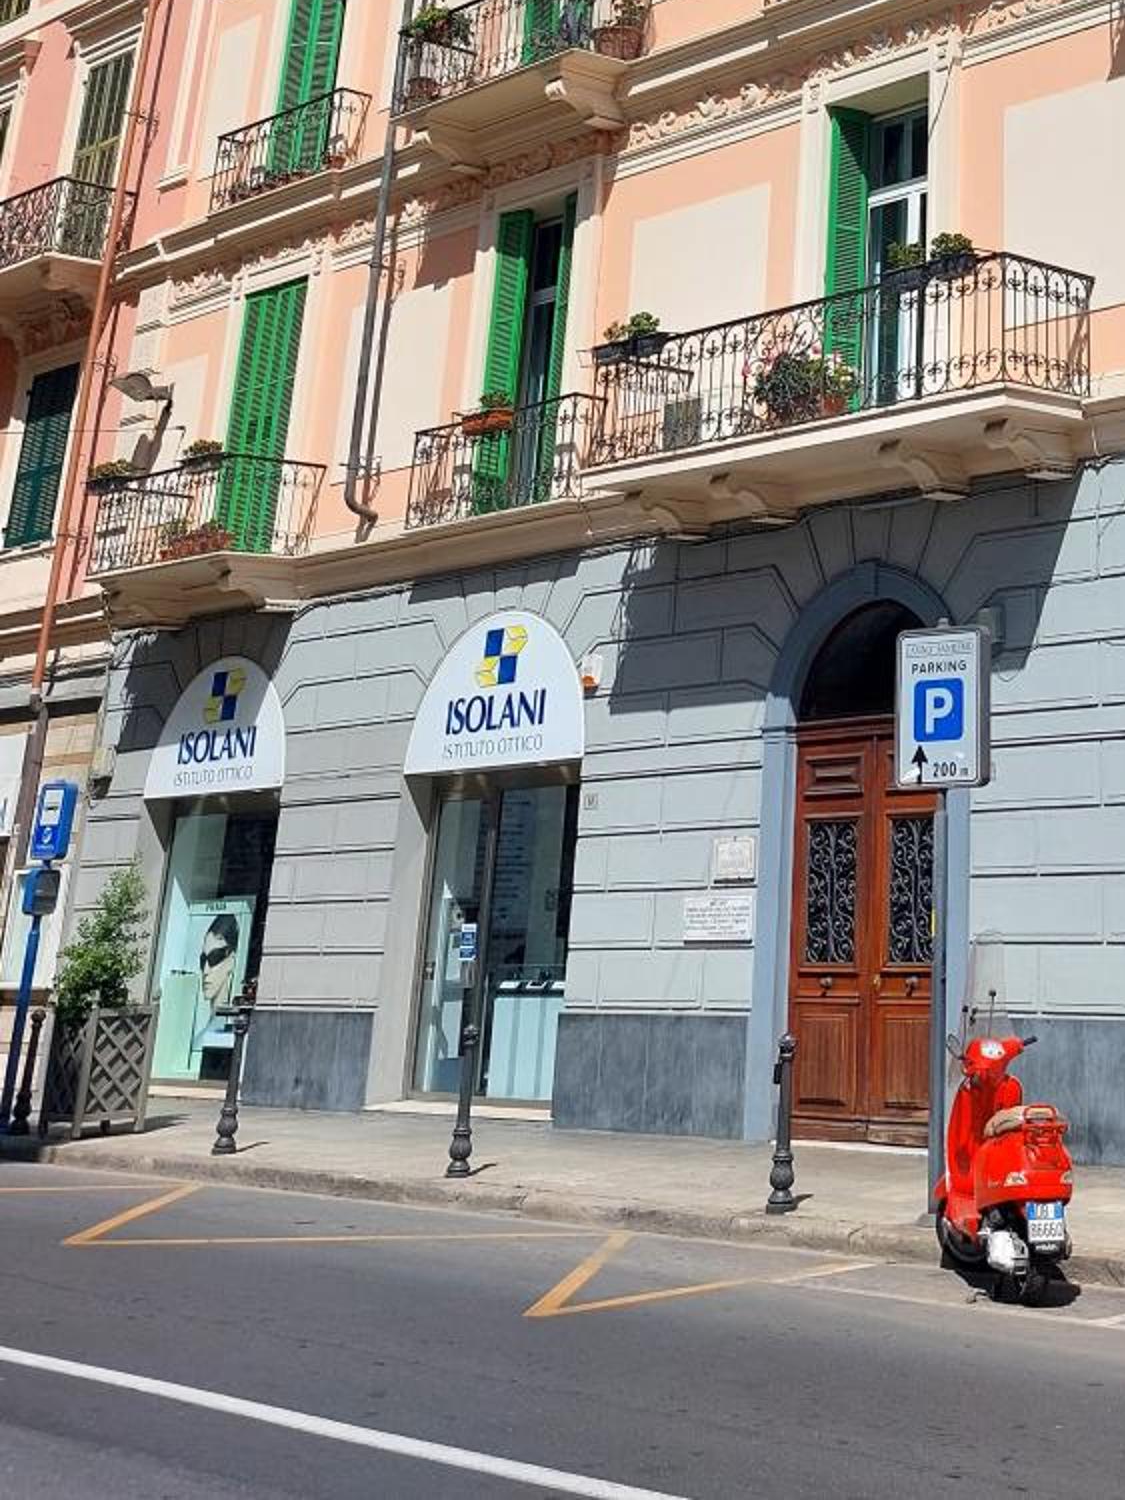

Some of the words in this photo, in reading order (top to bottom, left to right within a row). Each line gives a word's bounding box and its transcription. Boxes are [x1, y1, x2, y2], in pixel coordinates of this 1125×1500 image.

[911, 659, 967, 675] PARKING
[446, 688, 546, 735] ISOLANI
[925, 687, 953, 735] P
[177, 726, 257, 765] ISOLANI
[442, 739, 495, 759] ISTITUTO
[499, 734, 543, 752] OTTICO
[174, 768, 215, 787] ISTITUTO
[216, 765, 254, 784] OTTICO
[933, 760, 957, 777] 200
